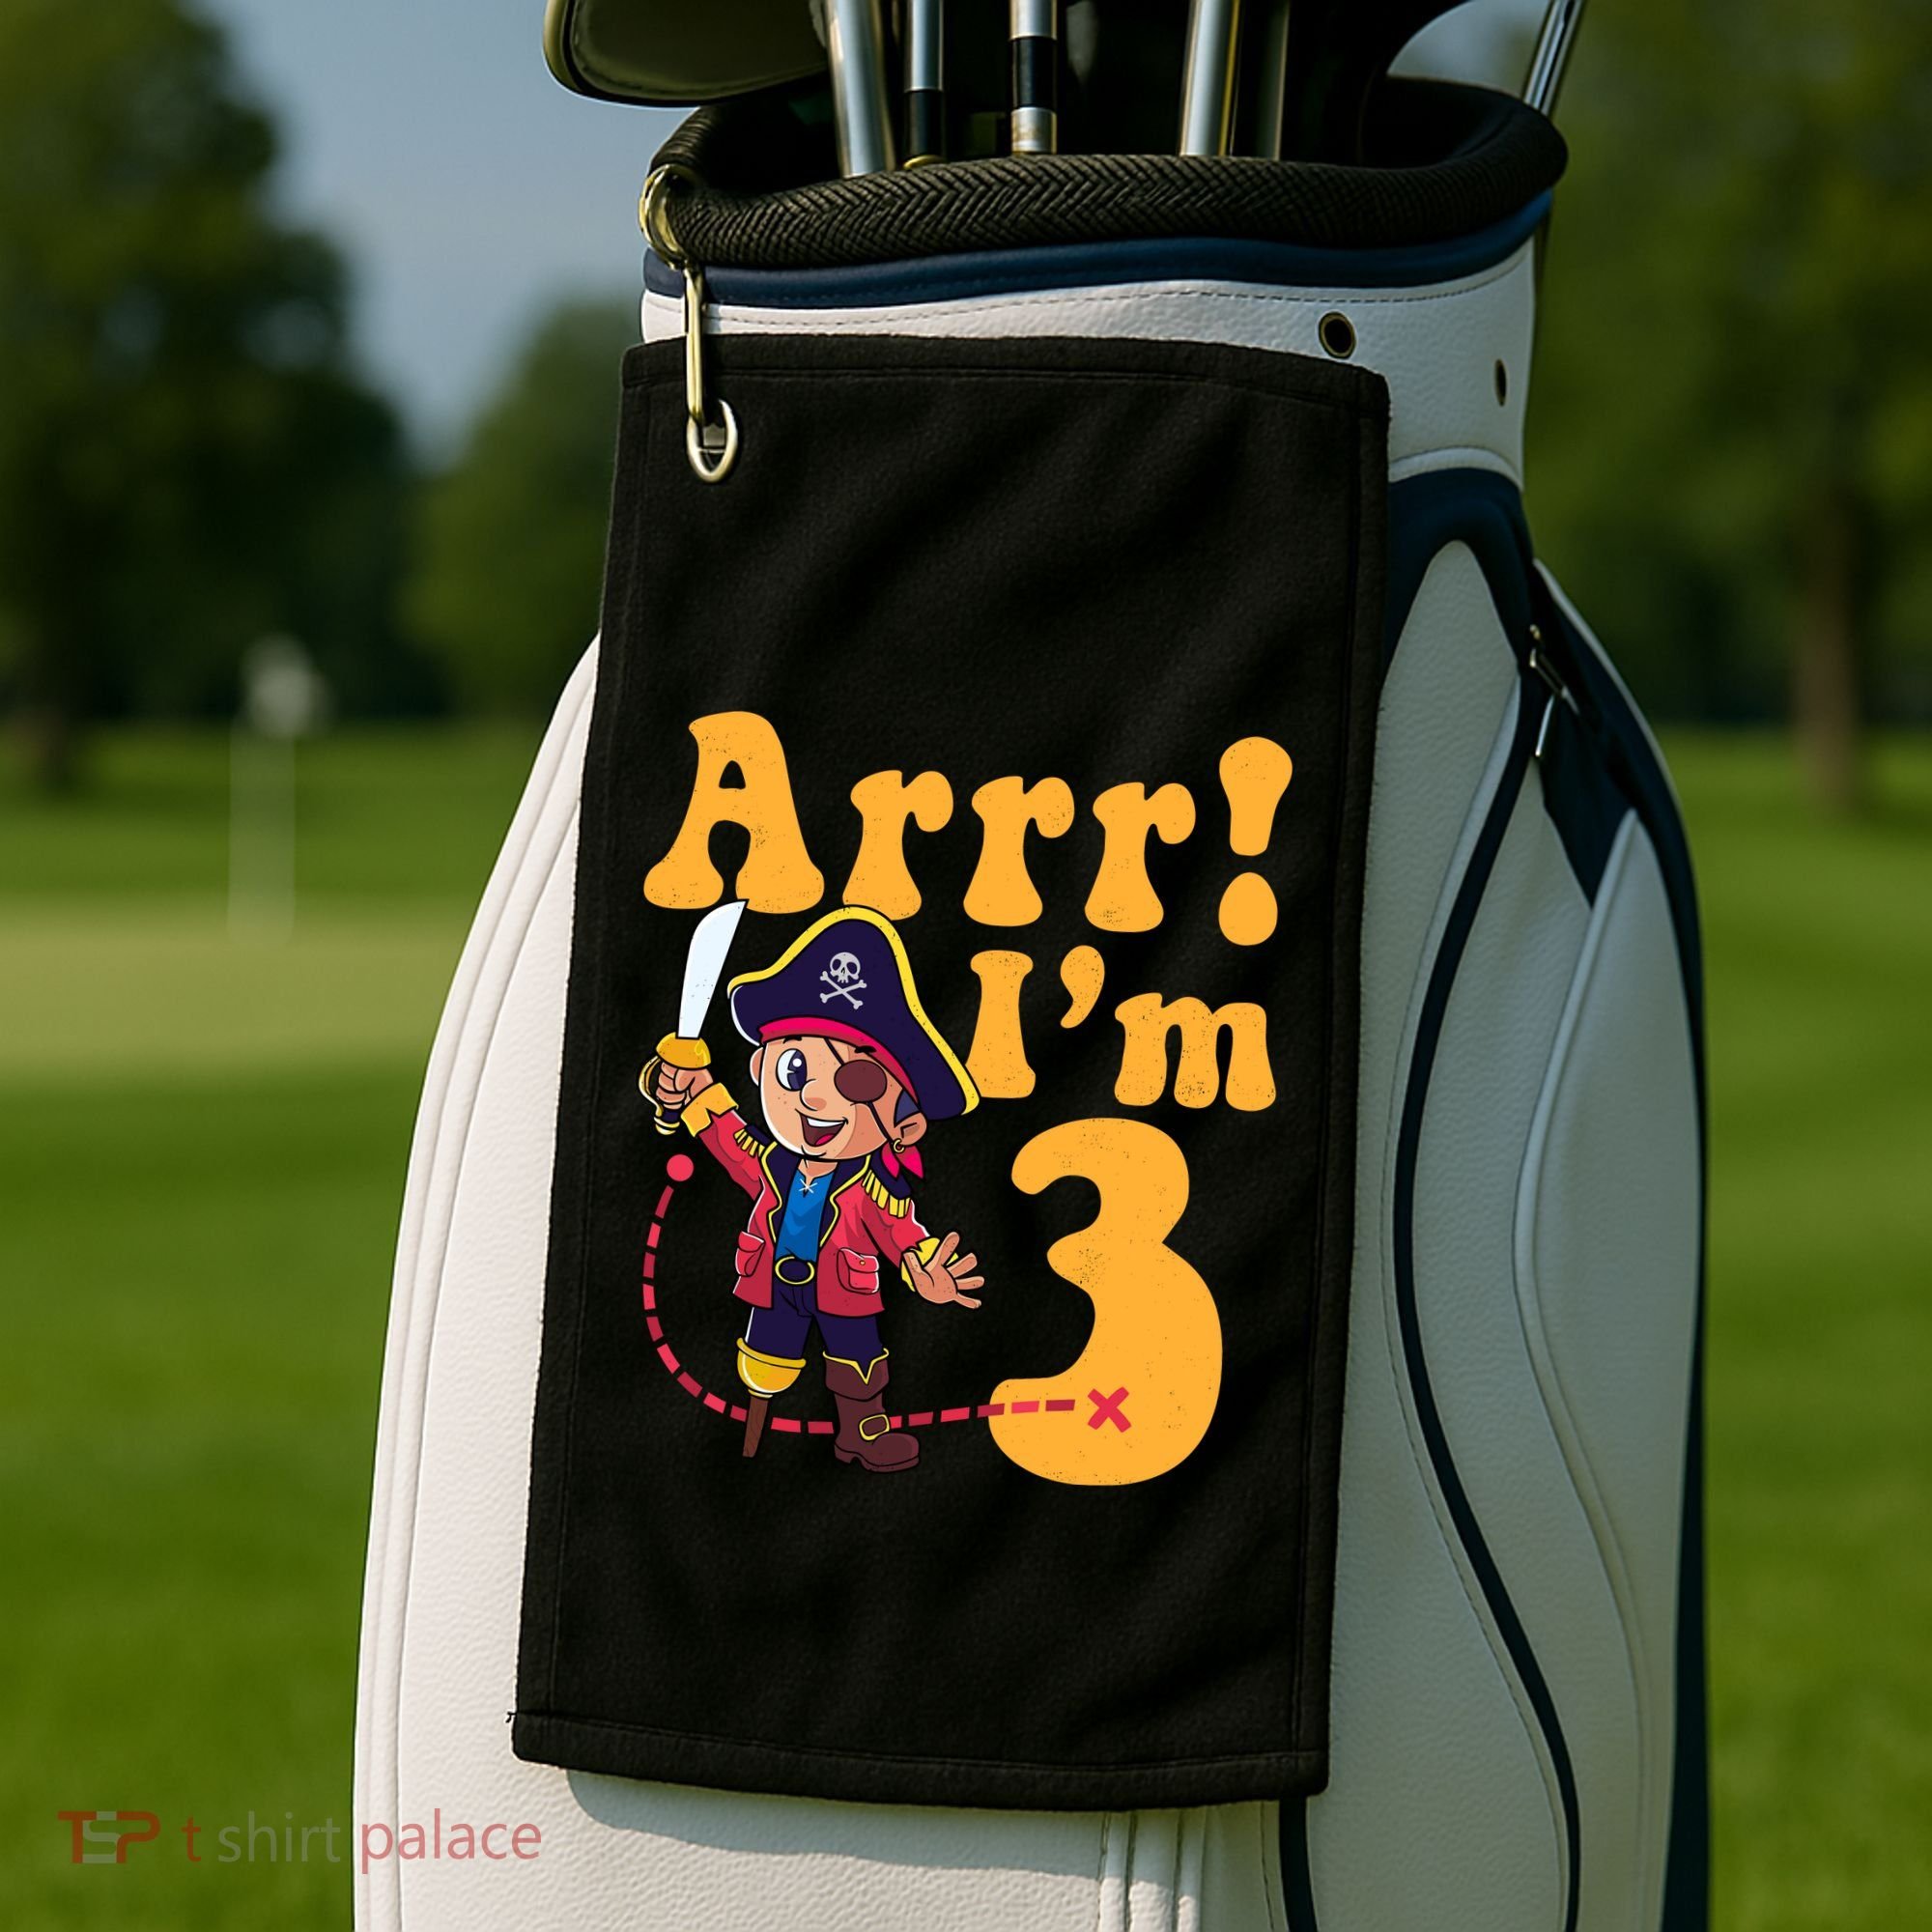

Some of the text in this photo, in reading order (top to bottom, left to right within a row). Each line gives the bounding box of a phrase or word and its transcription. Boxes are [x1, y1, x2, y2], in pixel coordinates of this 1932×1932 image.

[643, 711, 1293, 946] Arrr!
[966, 945, 1276, 1111] I’m
[988, 1118, 1223, 1486] 3
